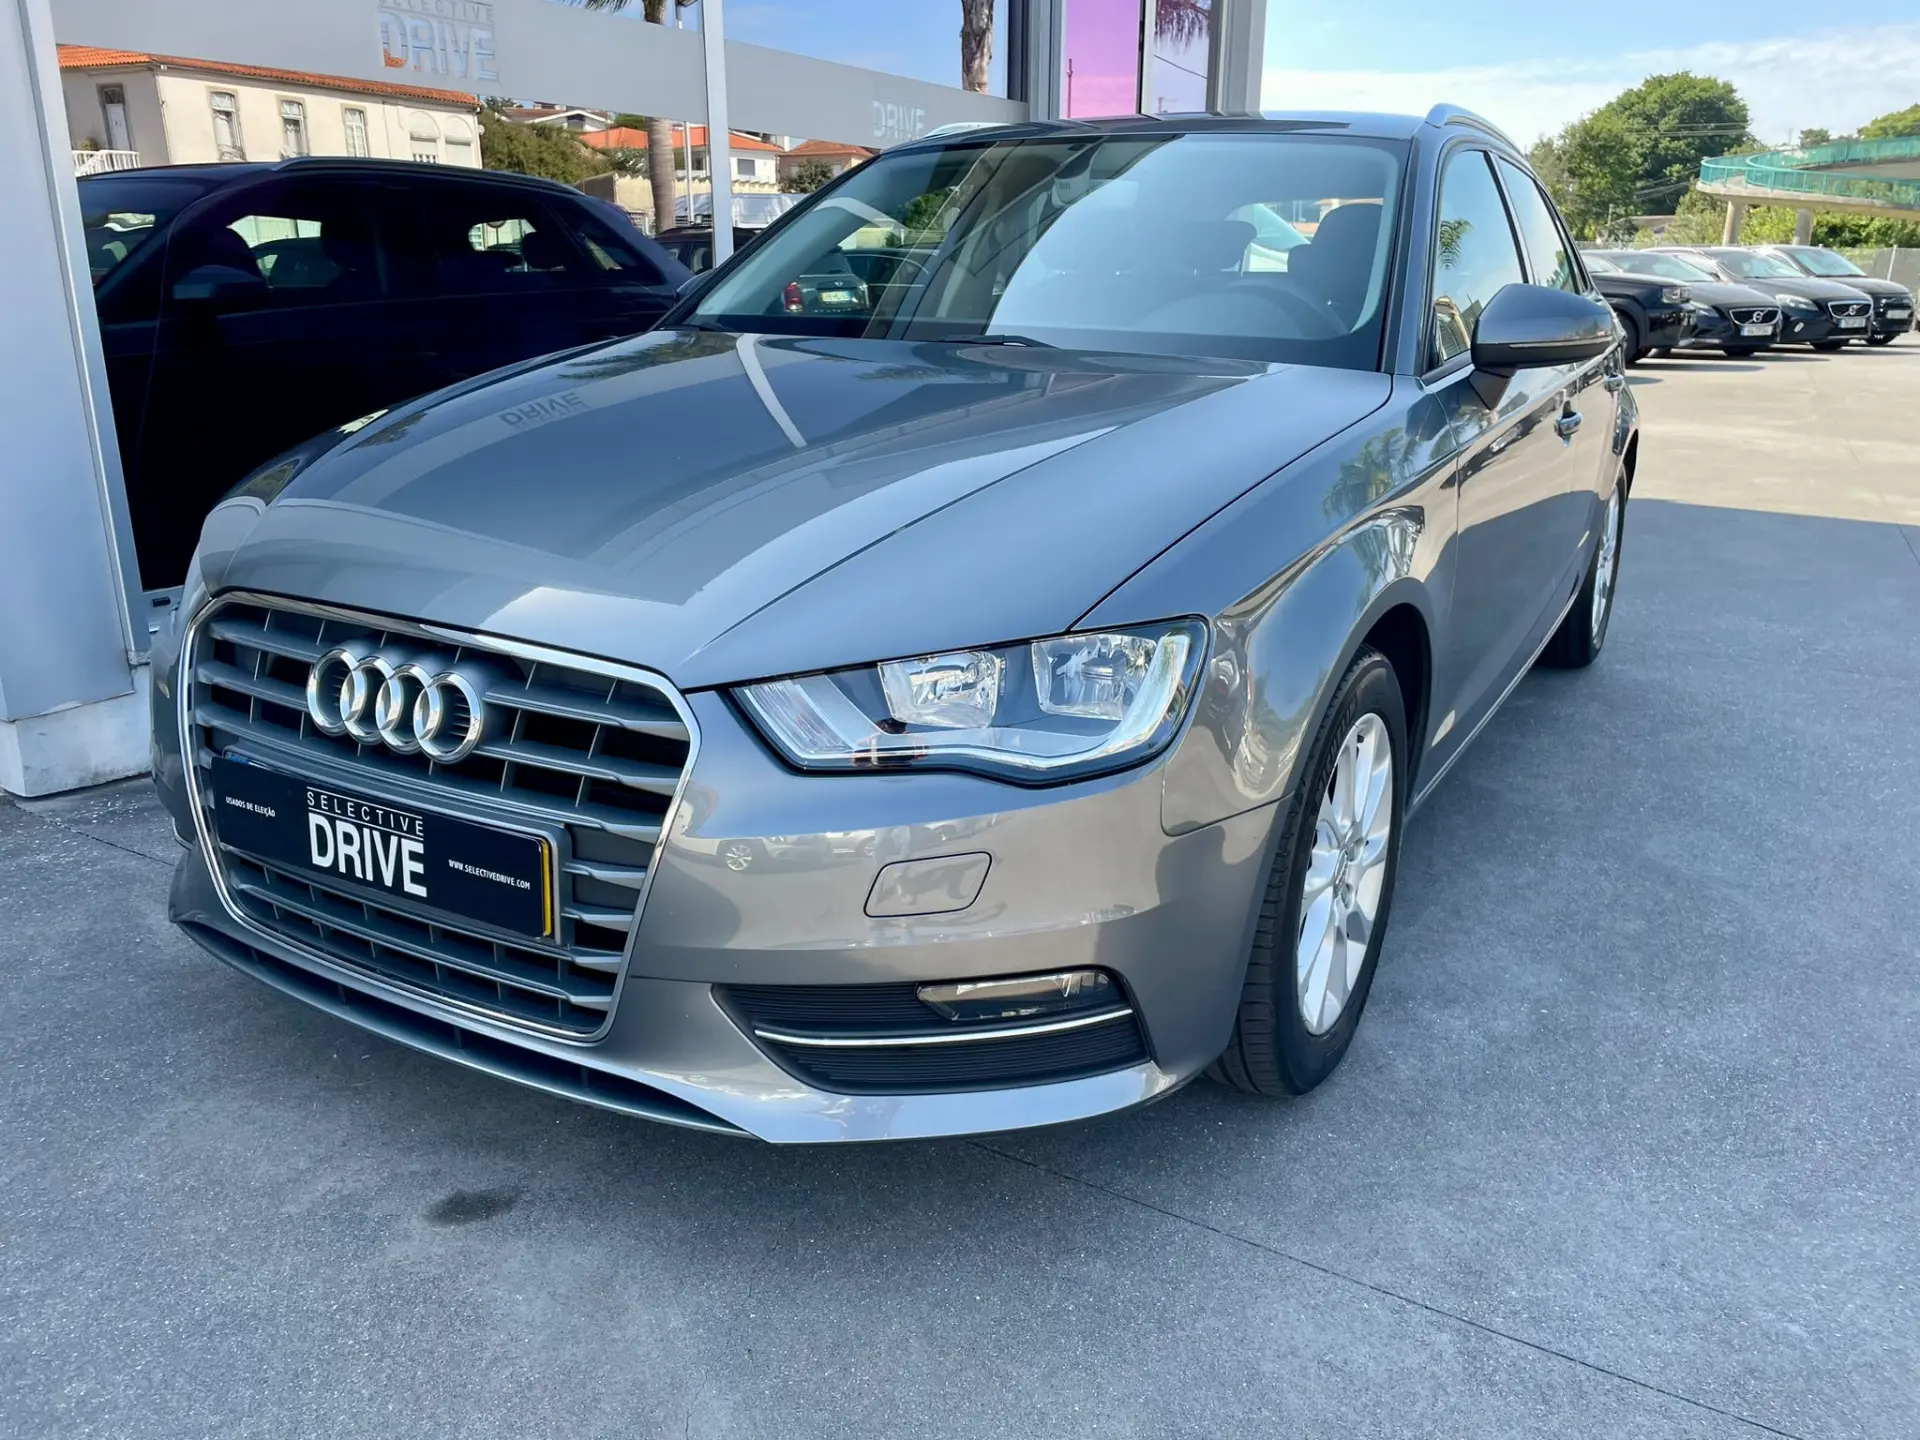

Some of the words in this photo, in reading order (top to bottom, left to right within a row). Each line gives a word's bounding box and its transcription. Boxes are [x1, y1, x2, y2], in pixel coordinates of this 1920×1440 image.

[379, 11, 499, 81] DRIVE
[873, 100, 926, 141] DRIVE
[225, 796, 246, 808] USADOS
[246, 801, 254, 811] DE
[306, 791, 424, 836] SELECTIVE
[308, 812, 428, 898] DRIVE
[448, 859, 531, 890] WWW.SELECTIVEDRIVE.COM
